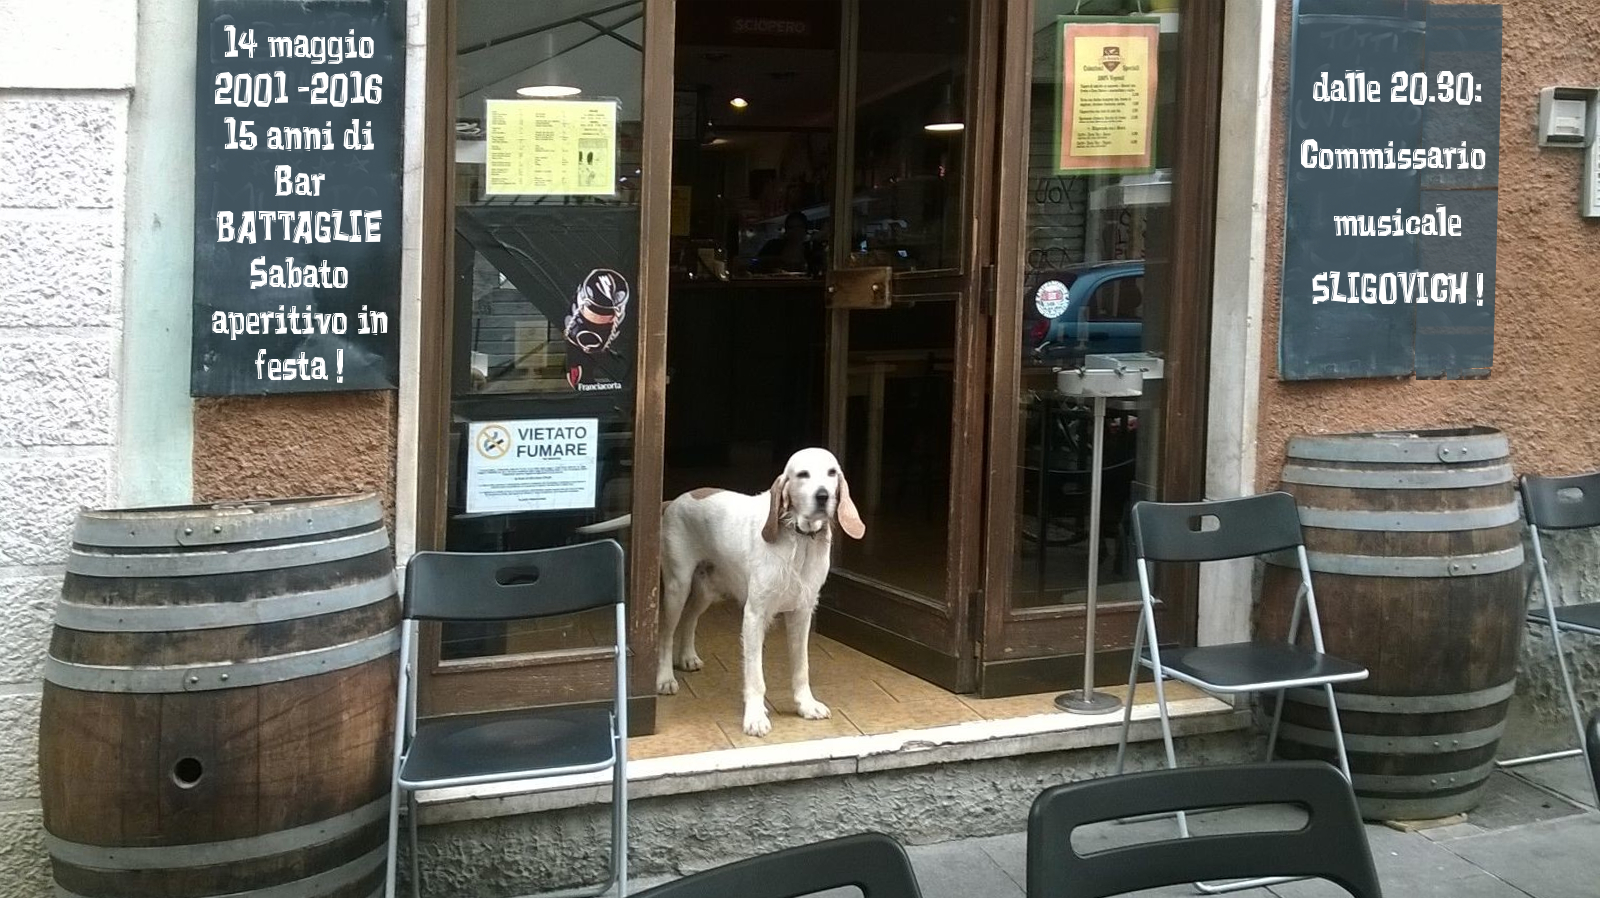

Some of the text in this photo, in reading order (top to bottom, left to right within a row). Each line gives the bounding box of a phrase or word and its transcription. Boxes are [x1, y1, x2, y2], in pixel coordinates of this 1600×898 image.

[577, 382, 621, 392] Franciacorta
[518, 426, 587, 440] VIETATO
[517, 443, 587, 457] FUMARE
